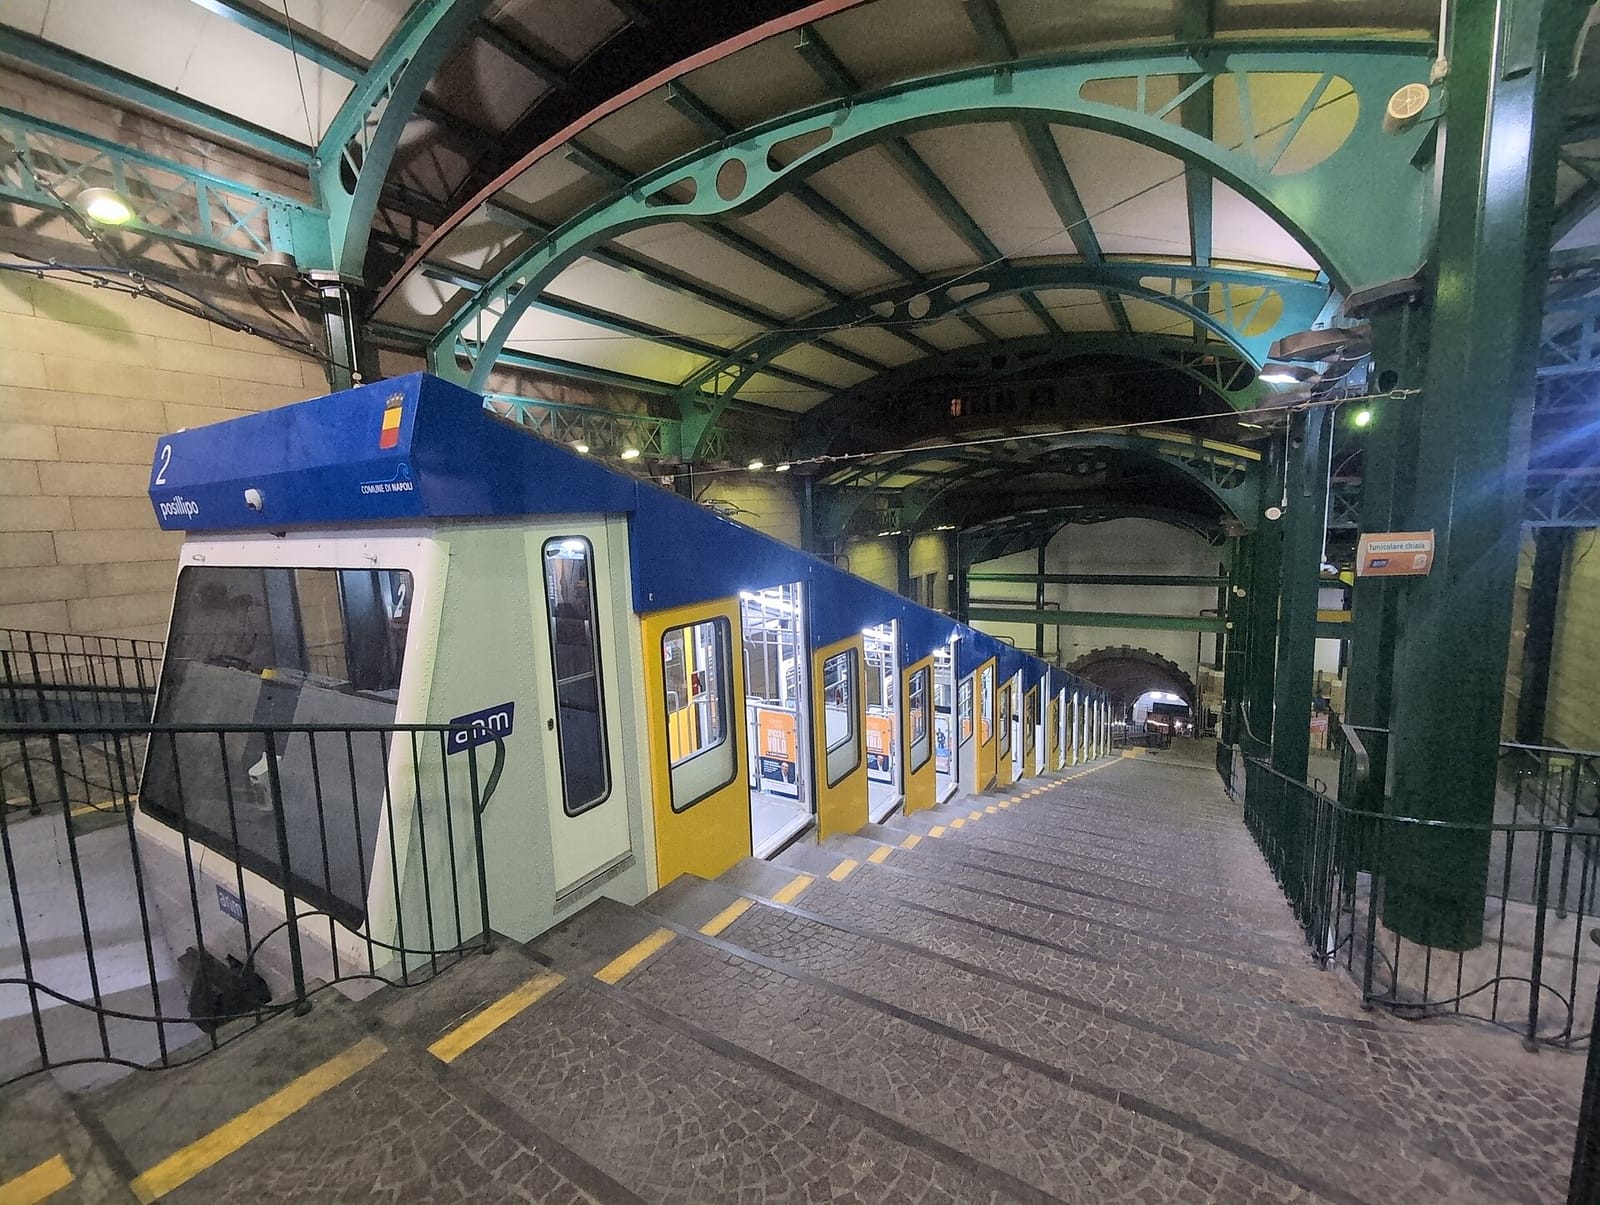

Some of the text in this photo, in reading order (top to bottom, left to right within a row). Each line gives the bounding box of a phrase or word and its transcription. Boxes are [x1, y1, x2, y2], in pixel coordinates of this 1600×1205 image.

[155, 444, 172, 486] 2
[361, 482, 413, 494] COMUNE DI NAPOLI
[160, 495, 199, 520] posillipo
[1369, 541, 1403, 551] funicolare
[393, 583, 406, 618] 2
